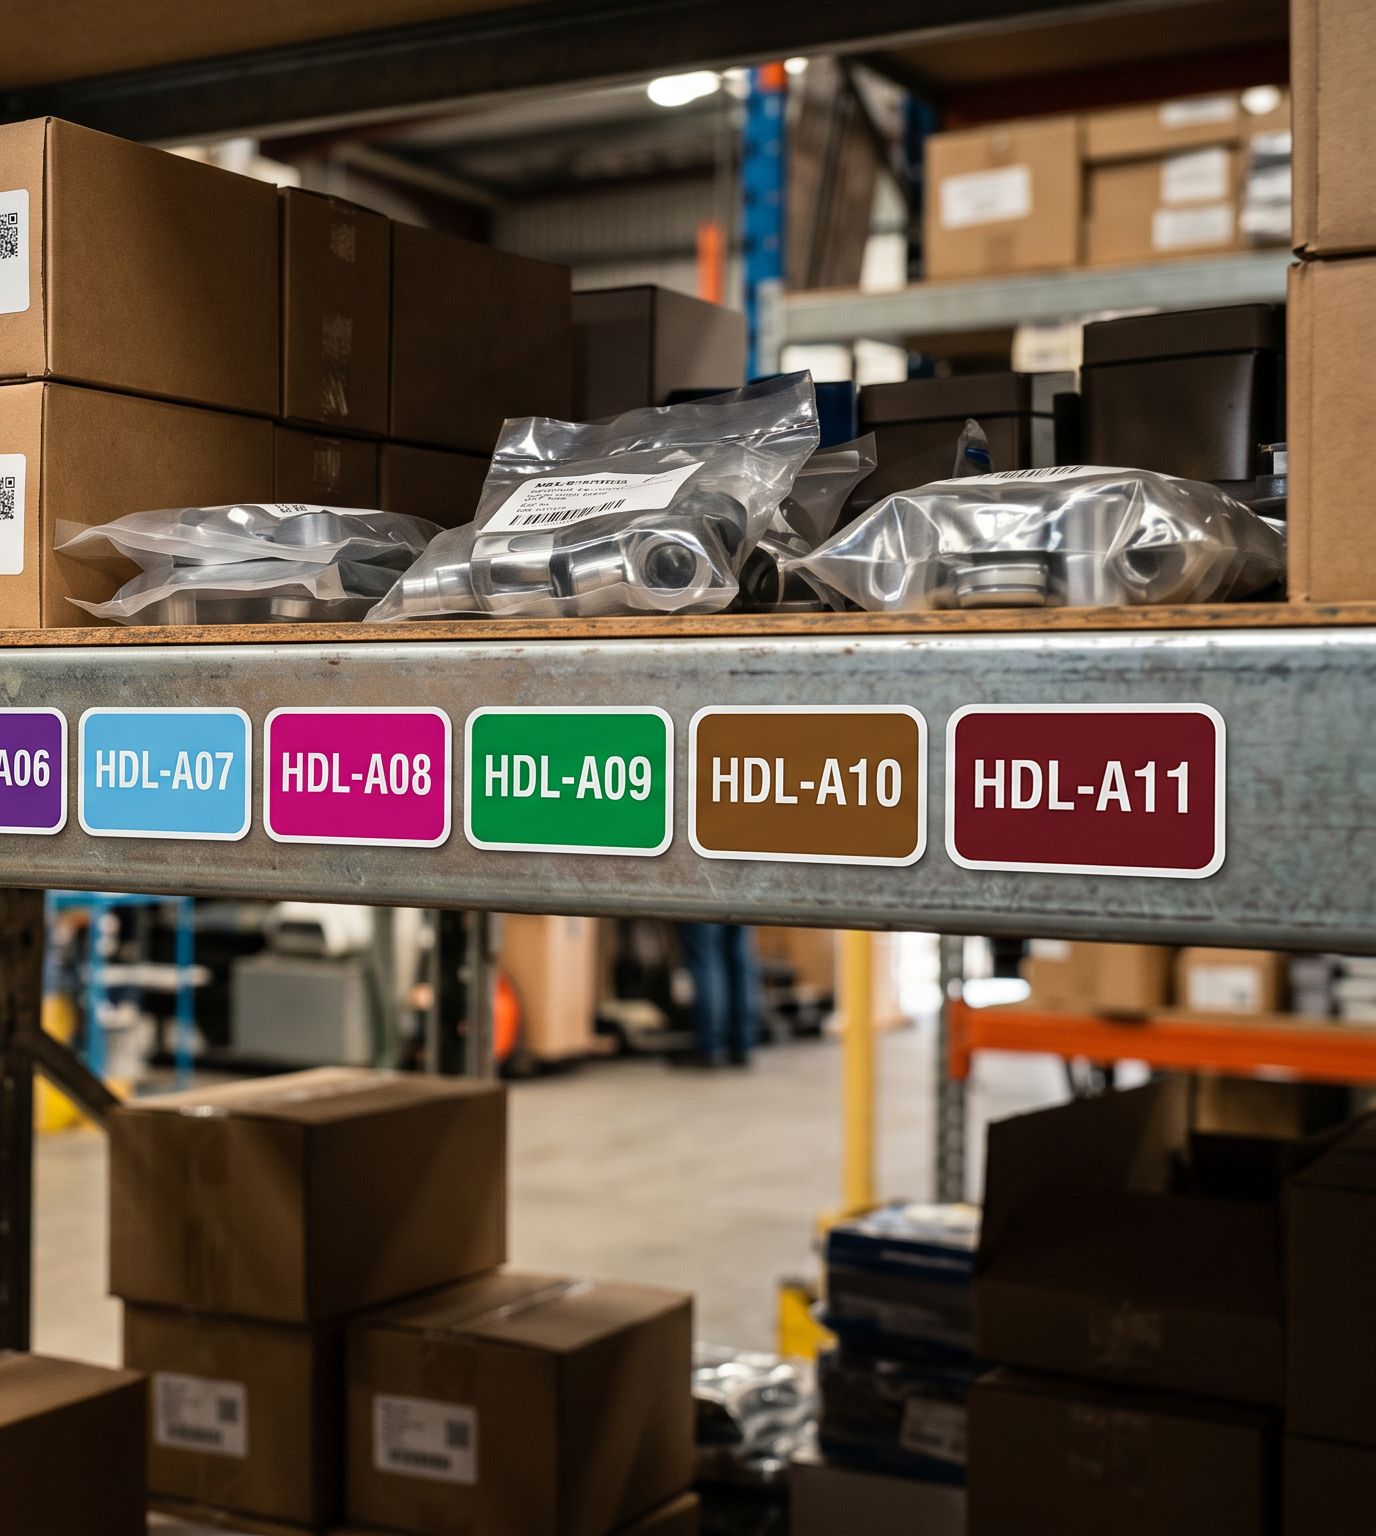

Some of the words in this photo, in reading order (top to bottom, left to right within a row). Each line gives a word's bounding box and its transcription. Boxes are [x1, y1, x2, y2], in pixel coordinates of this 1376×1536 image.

[97, 750, 233, 790] HDL-A07
[283, 753, 431, 795] HDL-A08
[486, 755, 651, 800] HDL-A09
[713, 758, 901, 807] HDL-A10
[975, 760, 1188, 813] HDL-A11
